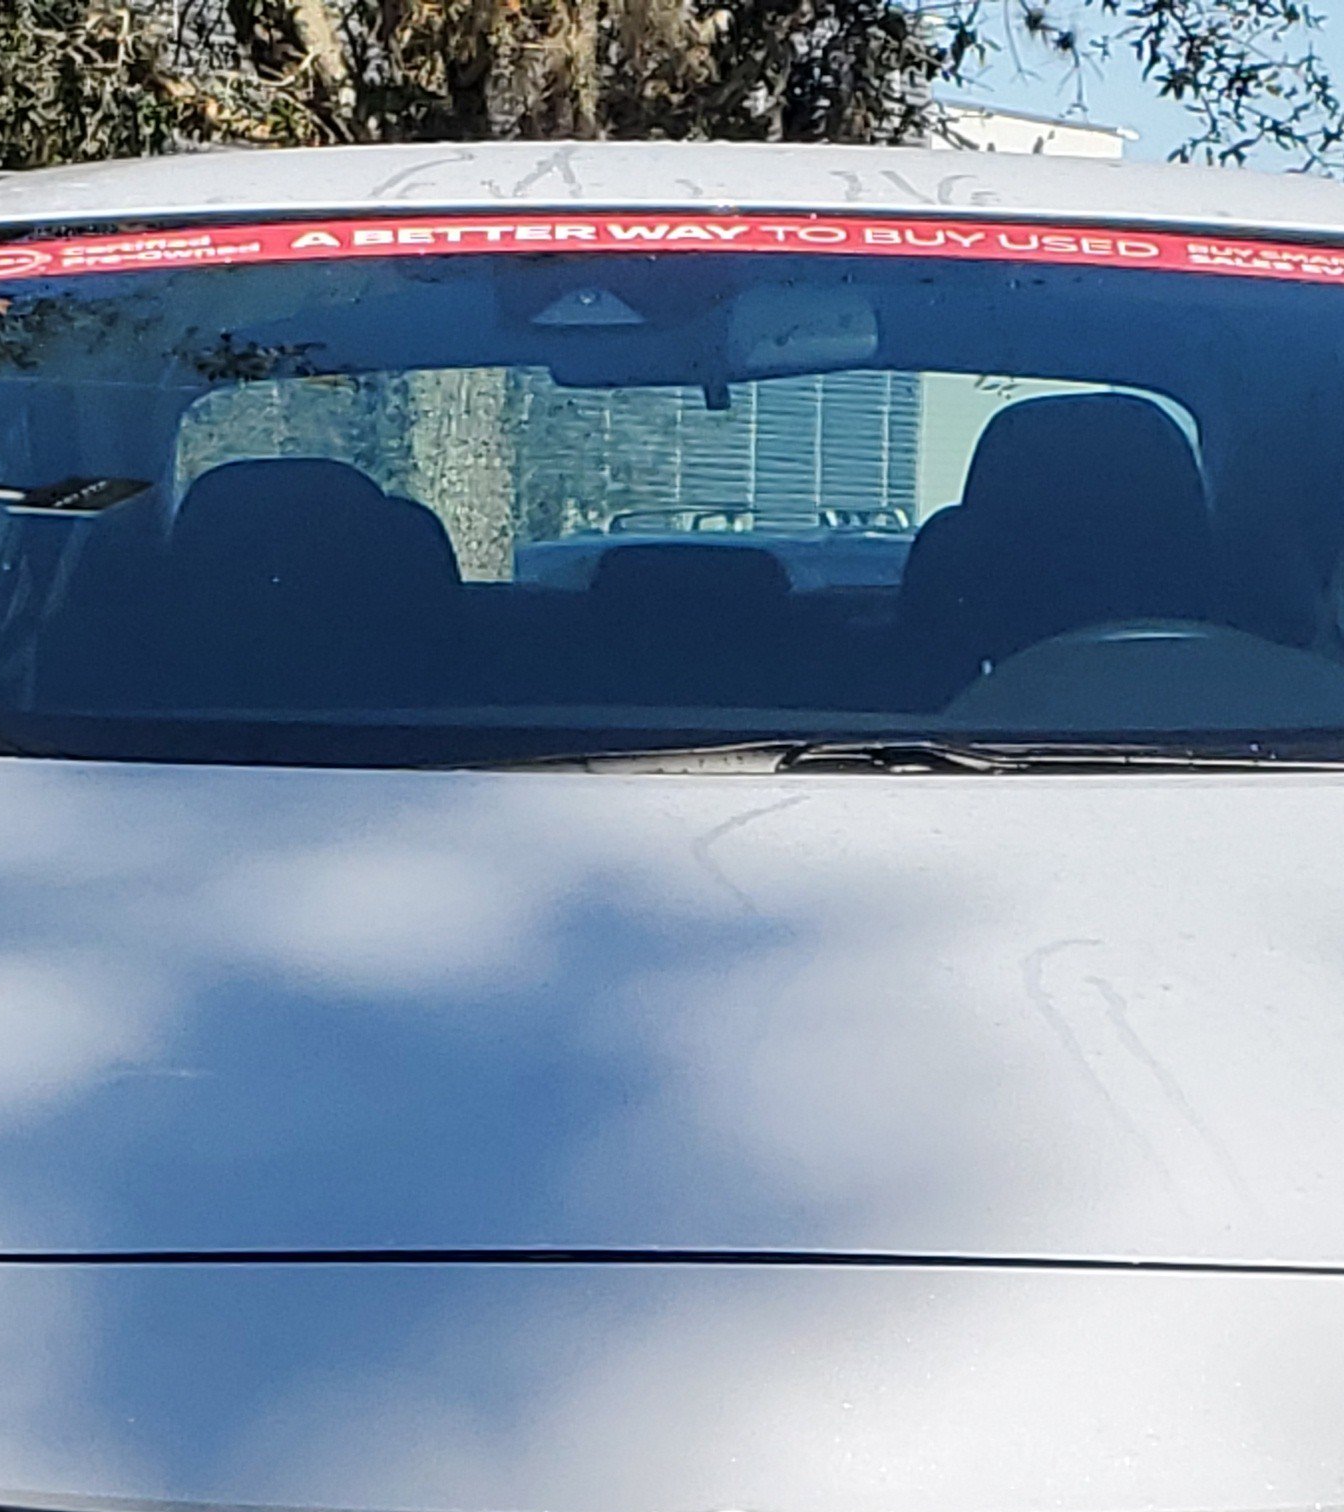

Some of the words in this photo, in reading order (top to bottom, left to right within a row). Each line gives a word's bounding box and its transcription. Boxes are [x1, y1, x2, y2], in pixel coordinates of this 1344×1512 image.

[291, 231, 341, 249] A
[354, 225, 598, 246] BETTER
[605, 223, 752, 242] WAY
[761, 225, 848, 243] TO
[864, 227, 987, 248] BUY
[998, 233, 1160, 258] USED
